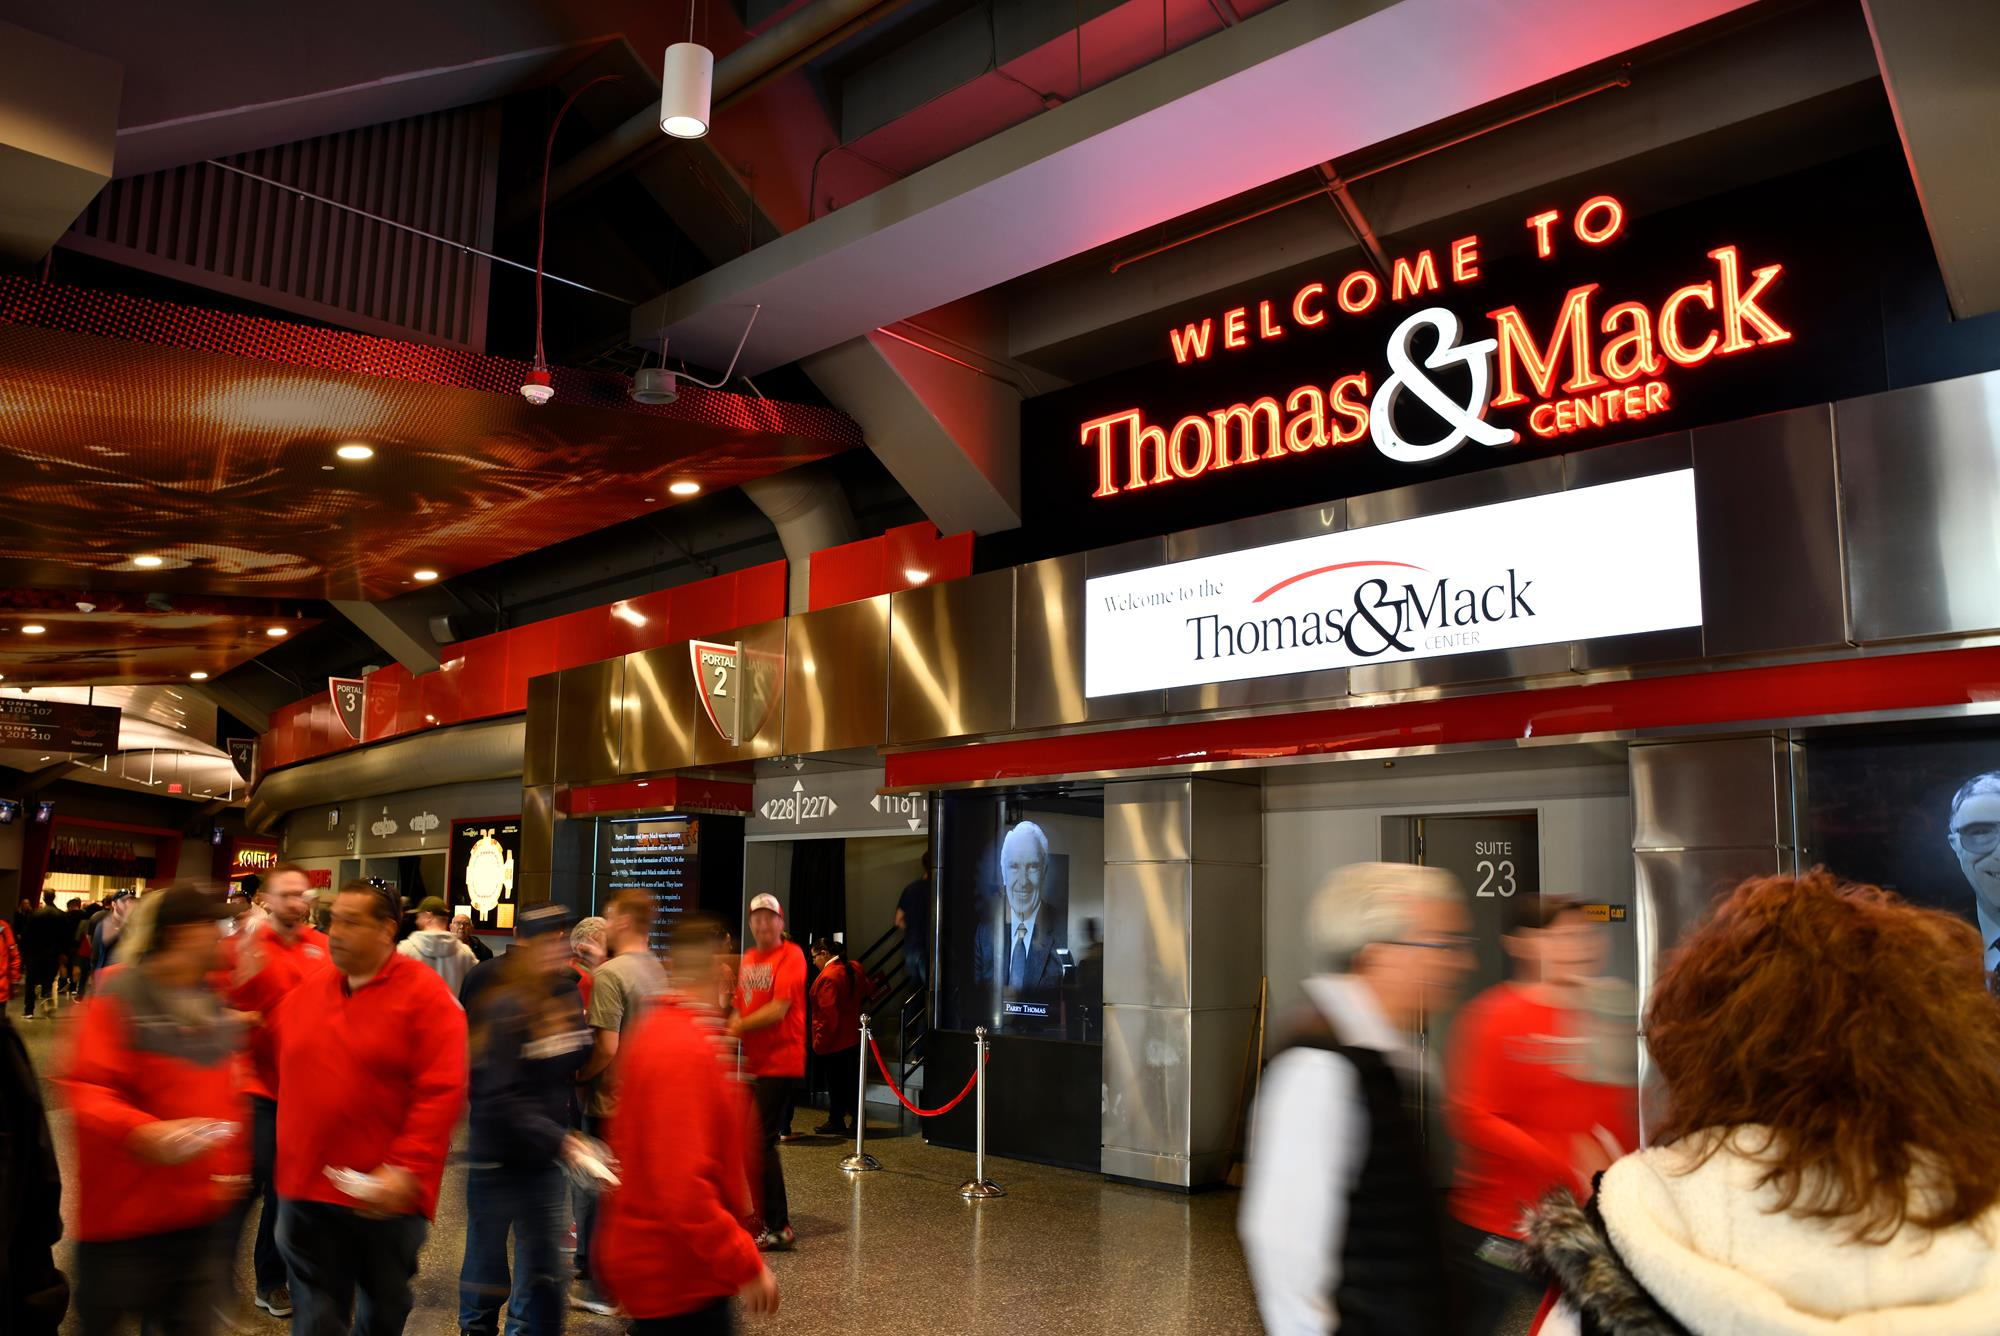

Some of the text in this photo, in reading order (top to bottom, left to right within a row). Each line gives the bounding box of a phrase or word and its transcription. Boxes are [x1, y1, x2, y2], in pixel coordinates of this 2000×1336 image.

[1169, 195, 1625, 364] WELCOME TO
[1081, 371, 1371, 498] Thomas
[1487, 245, 1791, 407] Mack
[1528, 381, 1671, 438] CENTER
[1104, 579, 1224, 612] Welcome to the
[1186, 608, 1344, 661] Thomas
[1401, 568, 1536, 632] Mack
[1424, 630, 1480, 650] CENTER
[702, 653, 736, 668] PORTAL
[337, 684, 362, 694] PORTAL
[713, 666, 728, 697] 2
[9, 706, 52, 716] 101-107
[345, 693, 355, 712] 3
[6, 731, 51, 741] 201-210
[240, 749, 248, 763] 4
[769, 798, 795, 820] 228
[801, 796, 829, 819] 227
[1475, 841, 1512, 856] SUITE
[239, 850, 270, 868] SOUTH
[1475, 860, 1516, 897] 23
[1610, 909, 1625, 919] CAT
[1023, 1005, 1046, 1014] THOMAS
